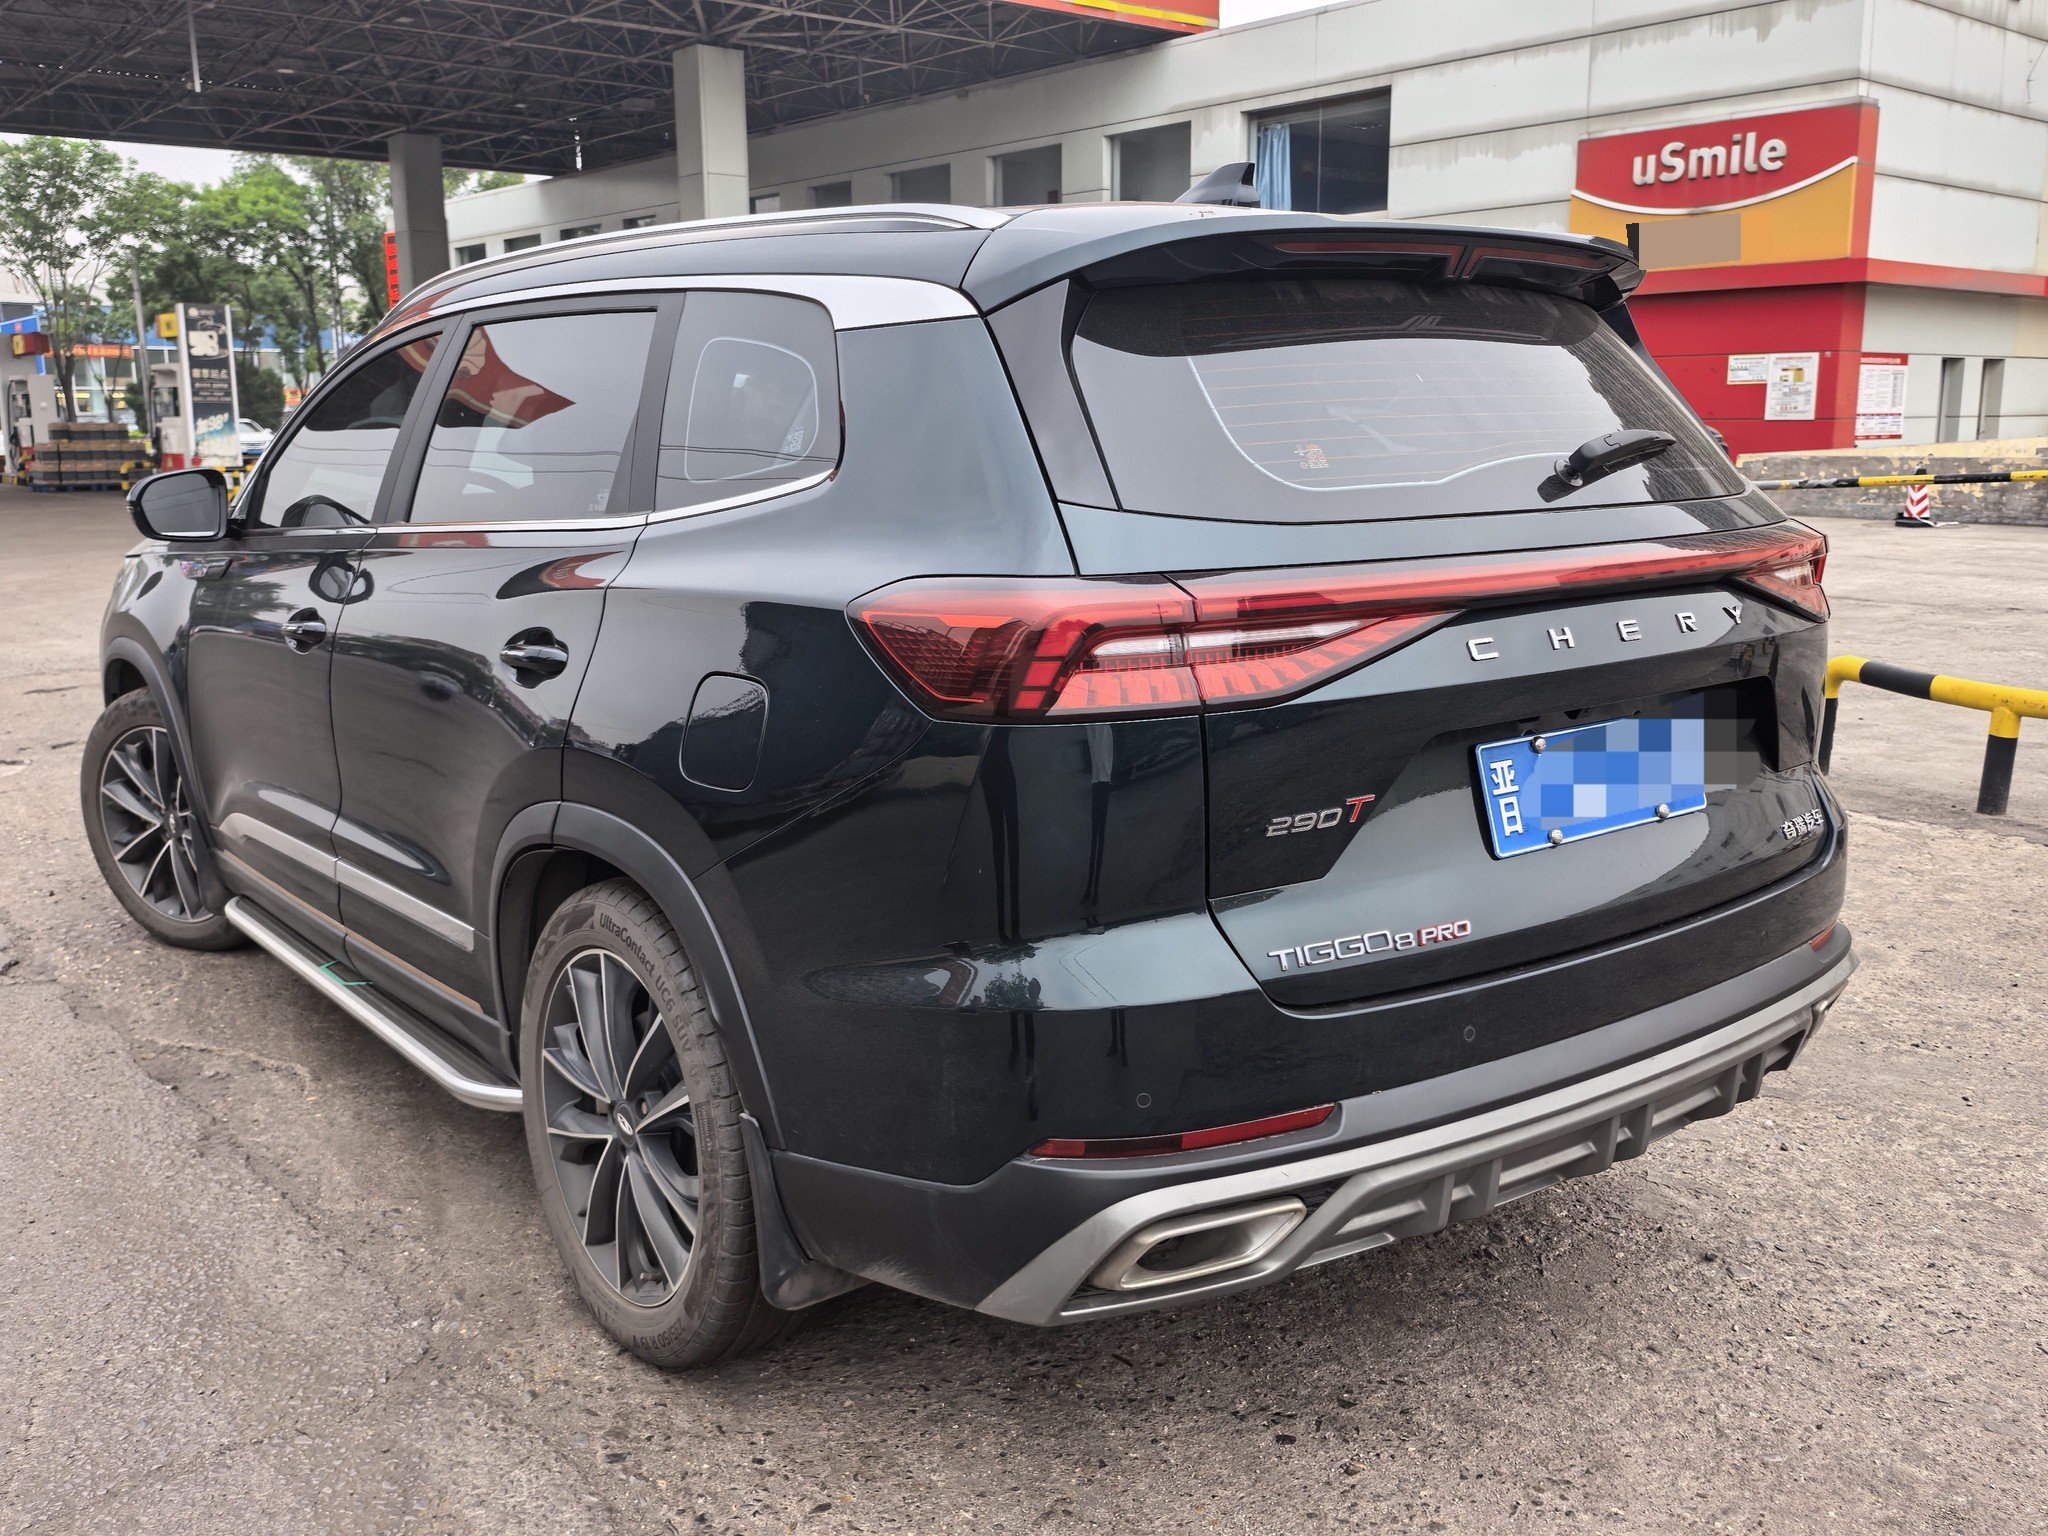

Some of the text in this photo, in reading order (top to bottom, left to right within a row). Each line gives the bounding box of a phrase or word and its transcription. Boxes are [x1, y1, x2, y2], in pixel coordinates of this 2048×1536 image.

[1632, 132, 1787, 186] uSmile
[1467, 604, 1742, 661] CHERY
[1265, 794, 1375, 837] 290T
[599, 911, 692, 1053] UltraContact UC6 SUV
